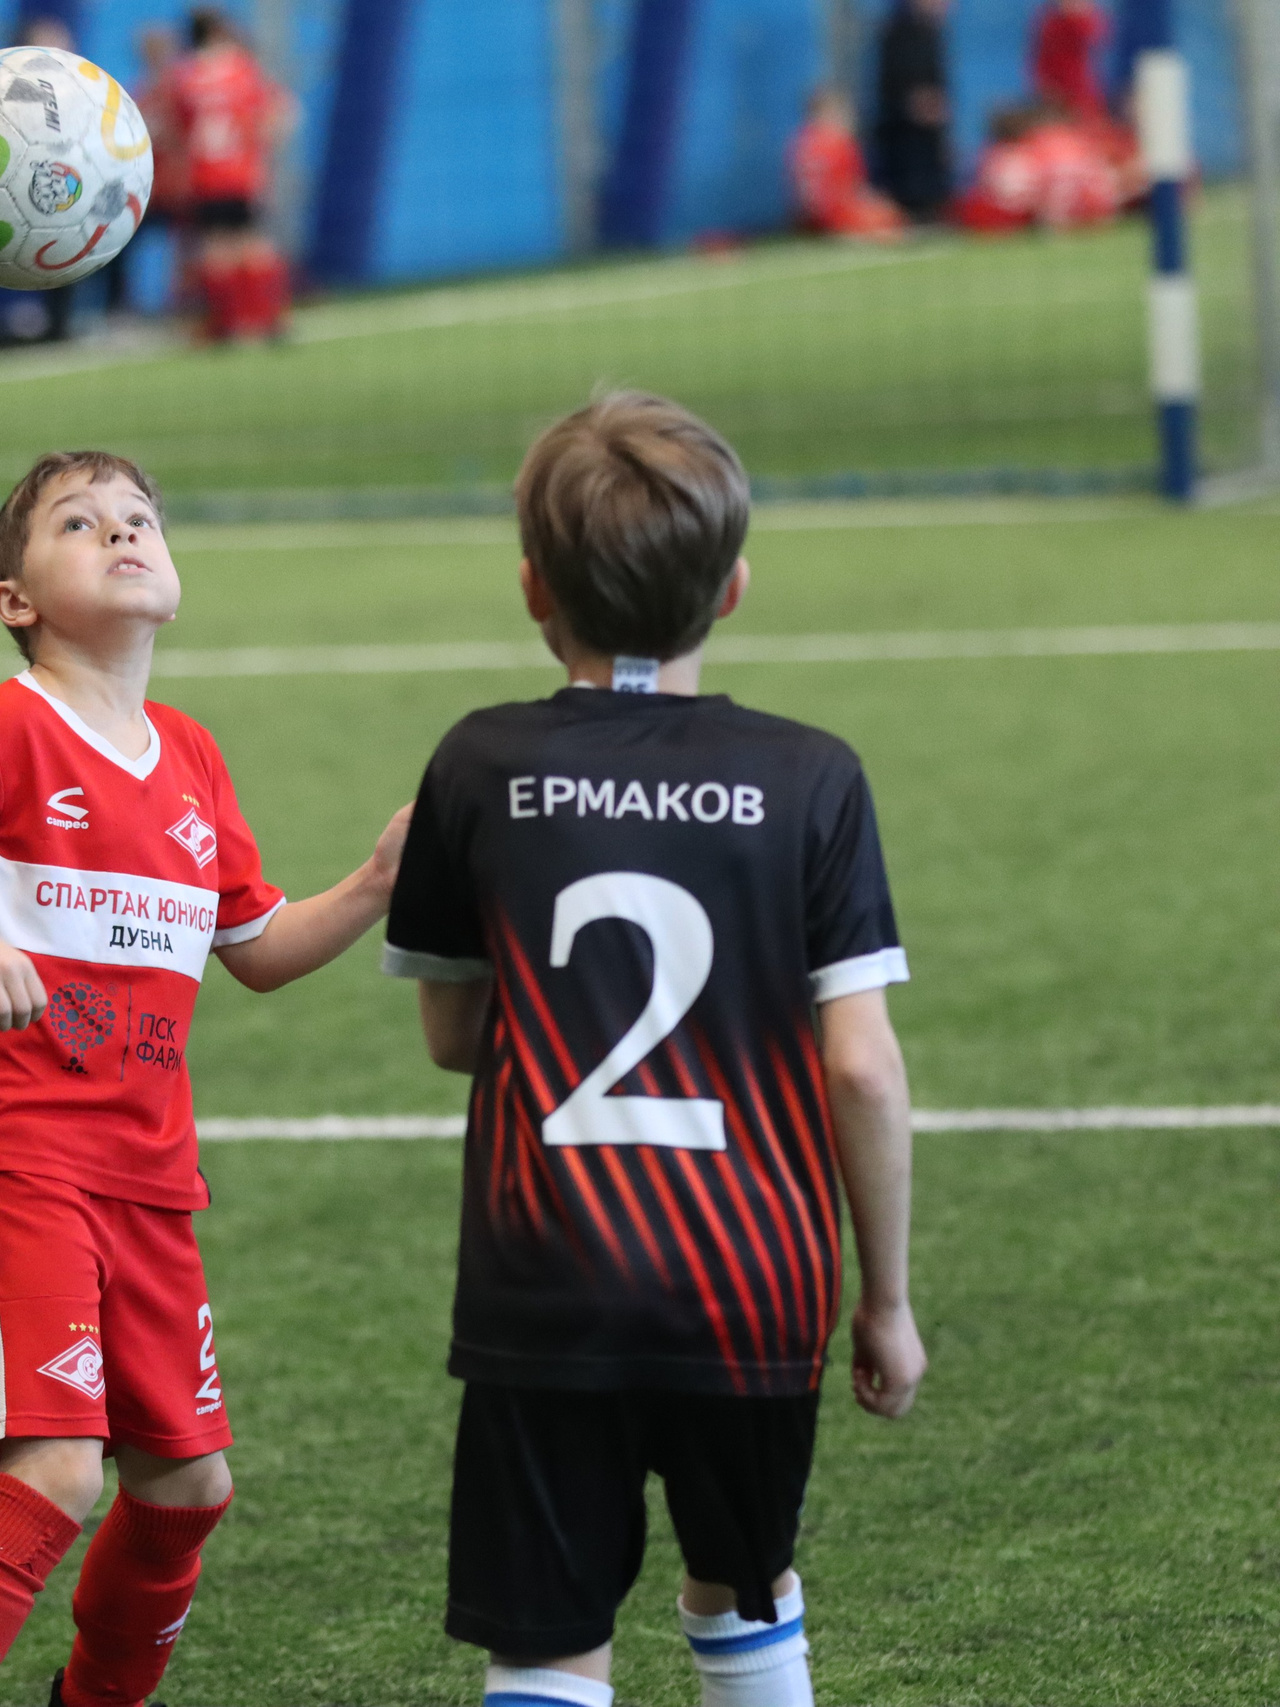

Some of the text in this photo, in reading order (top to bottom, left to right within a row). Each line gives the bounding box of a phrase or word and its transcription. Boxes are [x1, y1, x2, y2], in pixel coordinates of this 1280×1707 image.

[508, 775, 765, 825] ЕРМАКОВ
[46, 816, 89, 830] campeo
[36, 881, 215, 934] СПАРТАК ЮНИОР
[110, 925, 173, 954] ДУБНА
[139, 1013, 177, 1043] ПСК
[542, 871, 727, 1150] 2
